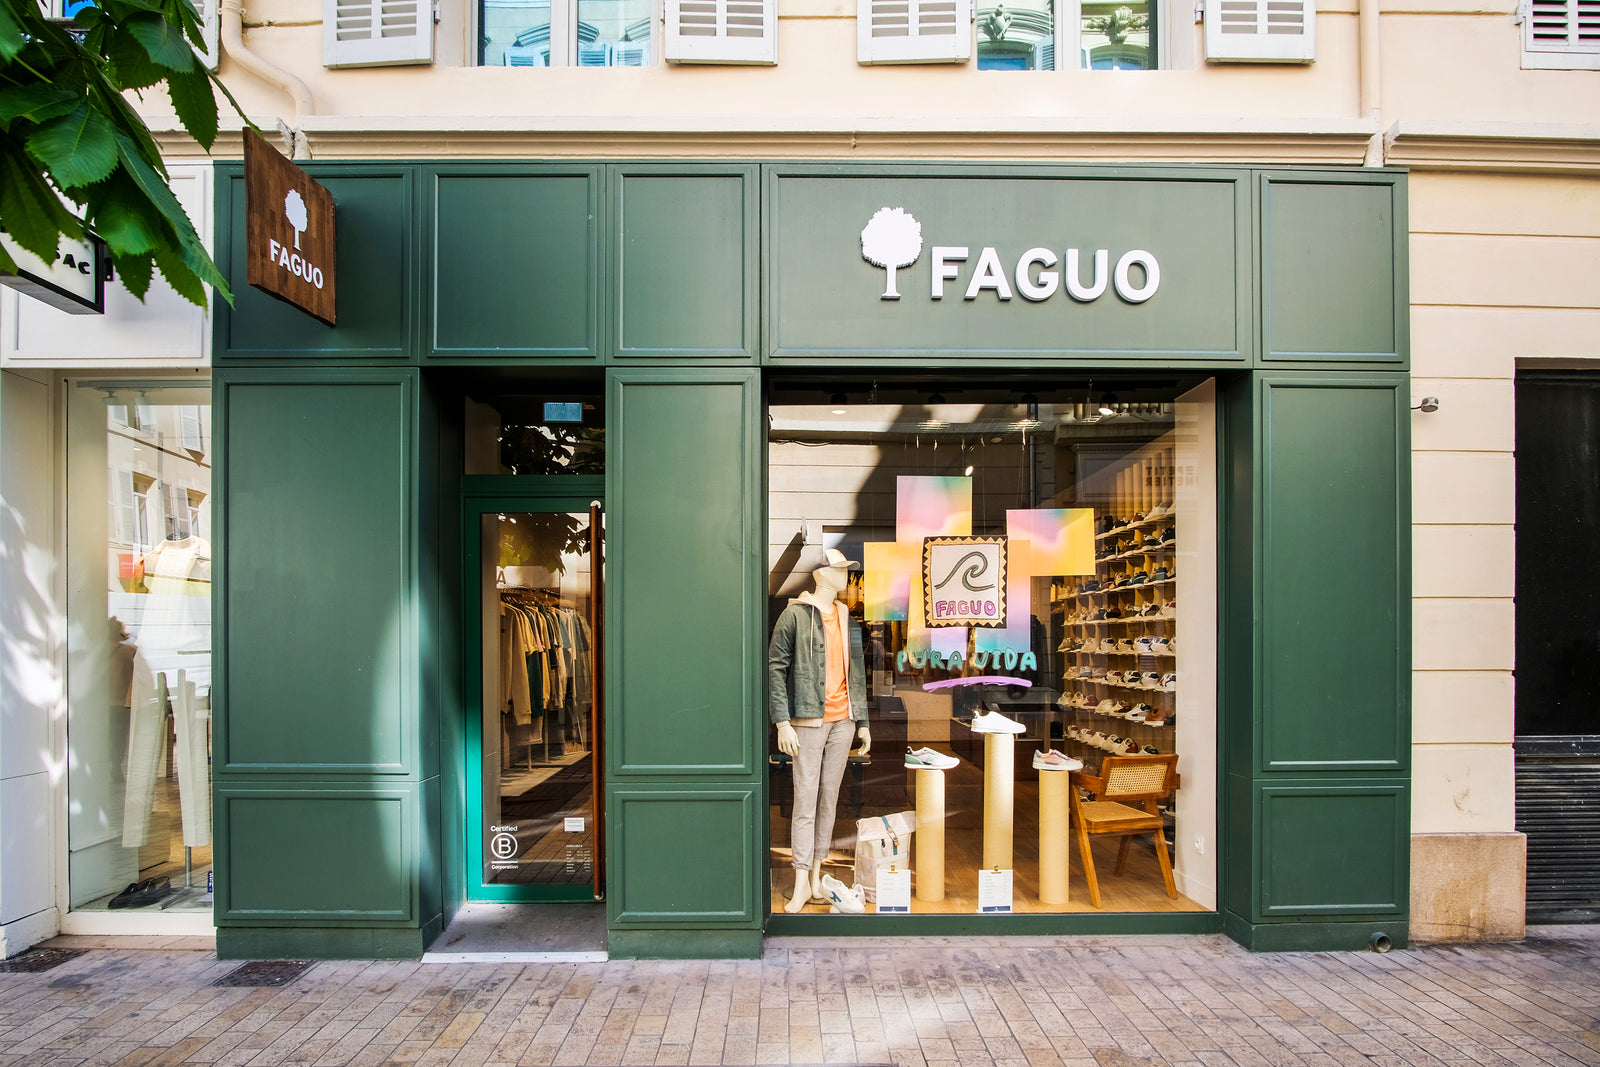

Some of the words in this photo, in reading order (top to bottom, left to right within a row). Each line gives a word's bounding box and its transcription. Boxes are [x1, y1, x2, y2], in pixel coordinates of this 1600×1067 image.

[270, 238, 324, 290] FAGUO
[930, 246, 1161, 303] FAGUO
[935, 600, 997, 617] FAGUO
[896, 648, 963, 672] PURA
[973, 646, 1038, 671] VIDA
[498, 838, 512, 854] B
